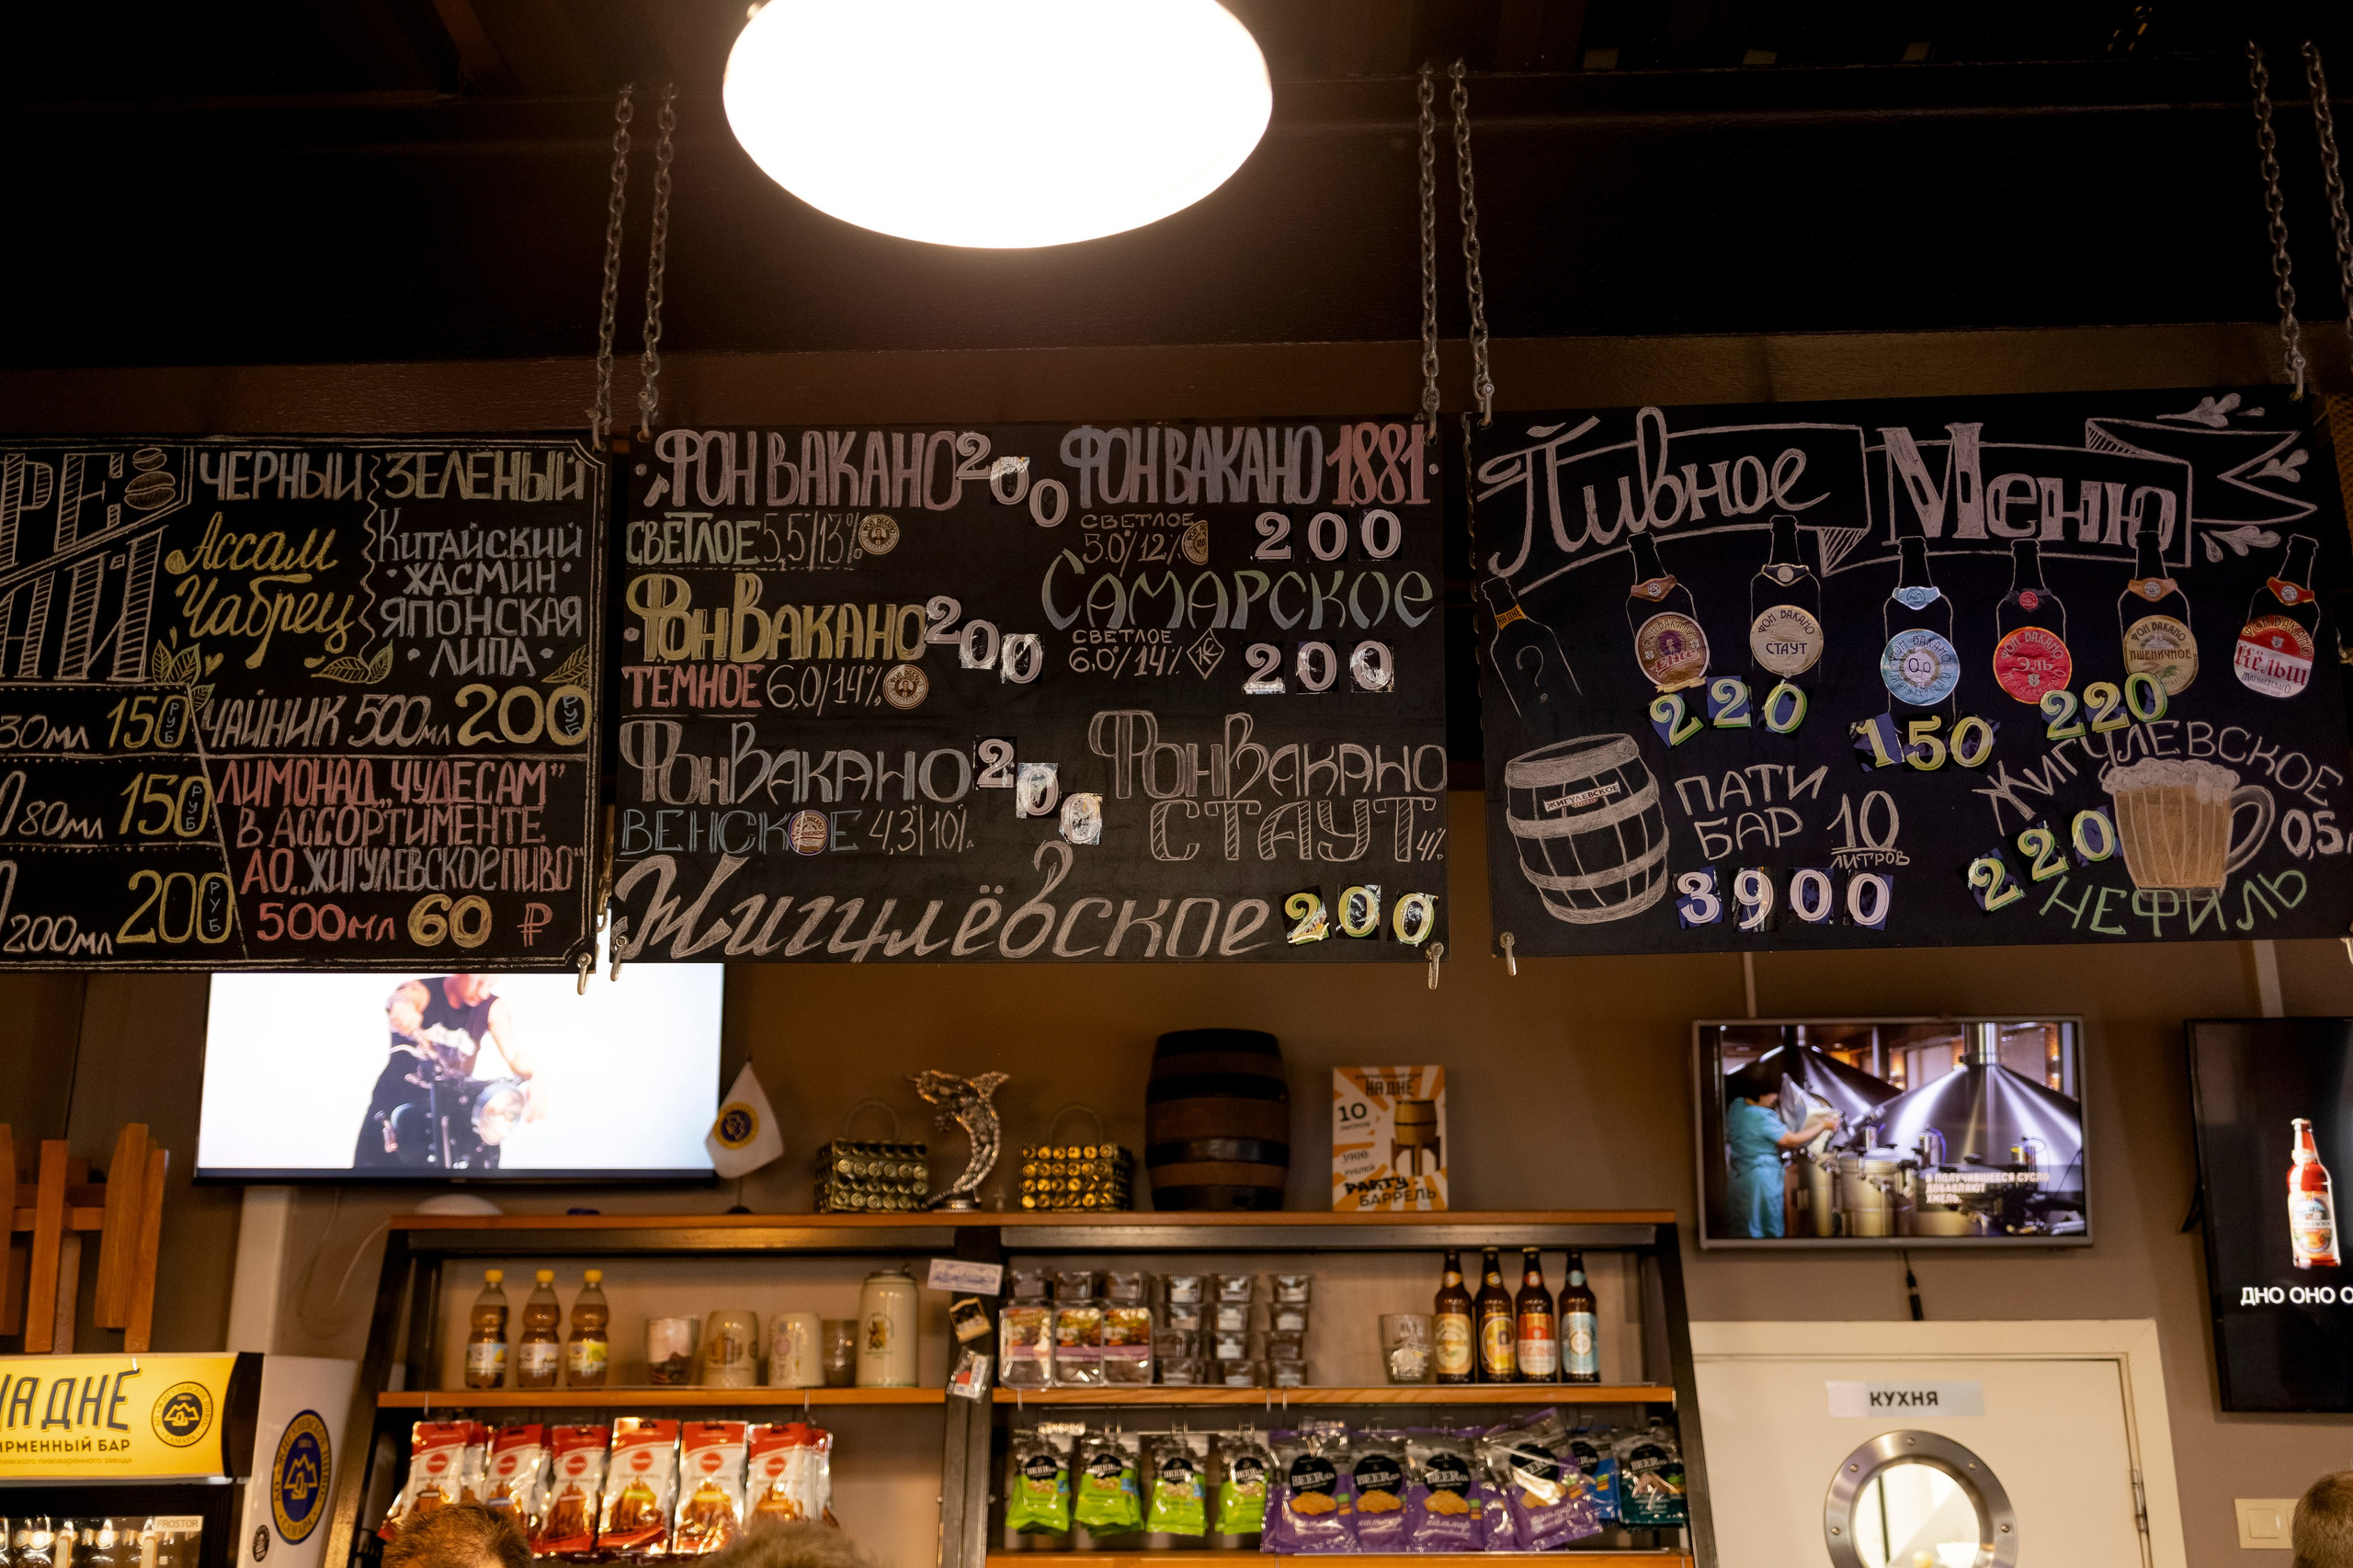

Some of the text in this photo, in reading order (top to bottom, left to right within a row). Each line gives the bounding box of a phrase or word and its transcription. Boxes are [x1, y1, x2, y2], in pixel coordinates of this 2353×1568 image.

[956, 430, 1071, 528] 200
[1325, 421, 1432, 506] 1881
[1476, 406, 2177, 579] Пивное Меню
[165, 512, 338, 574] Ассам
[625, 512, 763, 566] СВЕТЛОЕ
[1080, 511, 1195, 528] СВЕТЛОЕ
[1254, 509, 1403, 562] 200
[403, 561, 557, 597] ЖАСМИН
[175, 574, 356, 669] Чабрец
[380, 596, 583, 639] ЯПОНСКАЯ
[926, 595, 1044, 686] 200
[1073, 629, 1174, 644] СВЕТЛОЕ
[1757, 609, 1815, 635] ФОН ВАКАНО
[2131, 621, 2187, 642] ФОН ВАКАНО
[2242, 616, 2315, 657] ФОН ВАКАНО
[429, 637, 537, 678] ЛИПА
[1244, 641, 1394, 693] 200
[1650, 649, 1700, 678] Elite
[1766, 642, 1808, 654] СТАУТ
[2001, 631, 2064, 659] ФОН ВАКАНО
[2130, 649, 2192, 661] ПШЕНИЧНОЕ
[107, 695, 189, 749] 150
[201, 688, 347, 748] ЧАЙНИК
[455, 683, 591, 746] 200
[1648, 678, 1809, 747] 220
[2039, 671, 2170, 741] 220
[1859, 715, 1995, 771] 150
[119, 772, 211, 837] 150
[217, 758, 376, 807] ЛИМОНАД
[978, 736, 1103, 845] 200
[1546, 784, 1620, 810] ЖИГУЛЕВСКОЕ
[1675, 763, 1829, 816] ПАТИ
[236, 803, 547, 849] В АССОРТИМЕНТЕ
[620, 808, 863, 856] ВЕНСКЕ
[1150, 797, 1438, 862] СТАУТ
[1693, 807, 1803, 860] БАР
[1826, 790, 1901, 851] 10
[2280, 809, 2353, 860] 0,5
[1968, 809, 2115, 912] 220
[116, 869, 232, 944] 200
[407, 893, 494, 949] 60
[1284, 885, 1439, 946] 200
[1677, 869, 1891, 930] 3900
[2040, 869, 2307, 937] НЕФИЛЬ
[1337, 1103, 1367, 1122] 10
[1359, 1187, 1438, 1208] БАРРЕЛЬ
[1926, 1183, 1986, 1194] ДОБАВЛЯЮТ
[2017, 1172, 2051, 1183] СУСЛО
[2240, 1286, 2285, 1306] ДНО
[2289, 1286, 2336, 1304] ОНО
[40, 1368, 141, 1432] ДНЕ
[1869, 1390, 1939, 1408] КУХНЯ
[98, 1438, 131, 1452] БАР
[156, 1518, 199, 1529] FROSTOR
